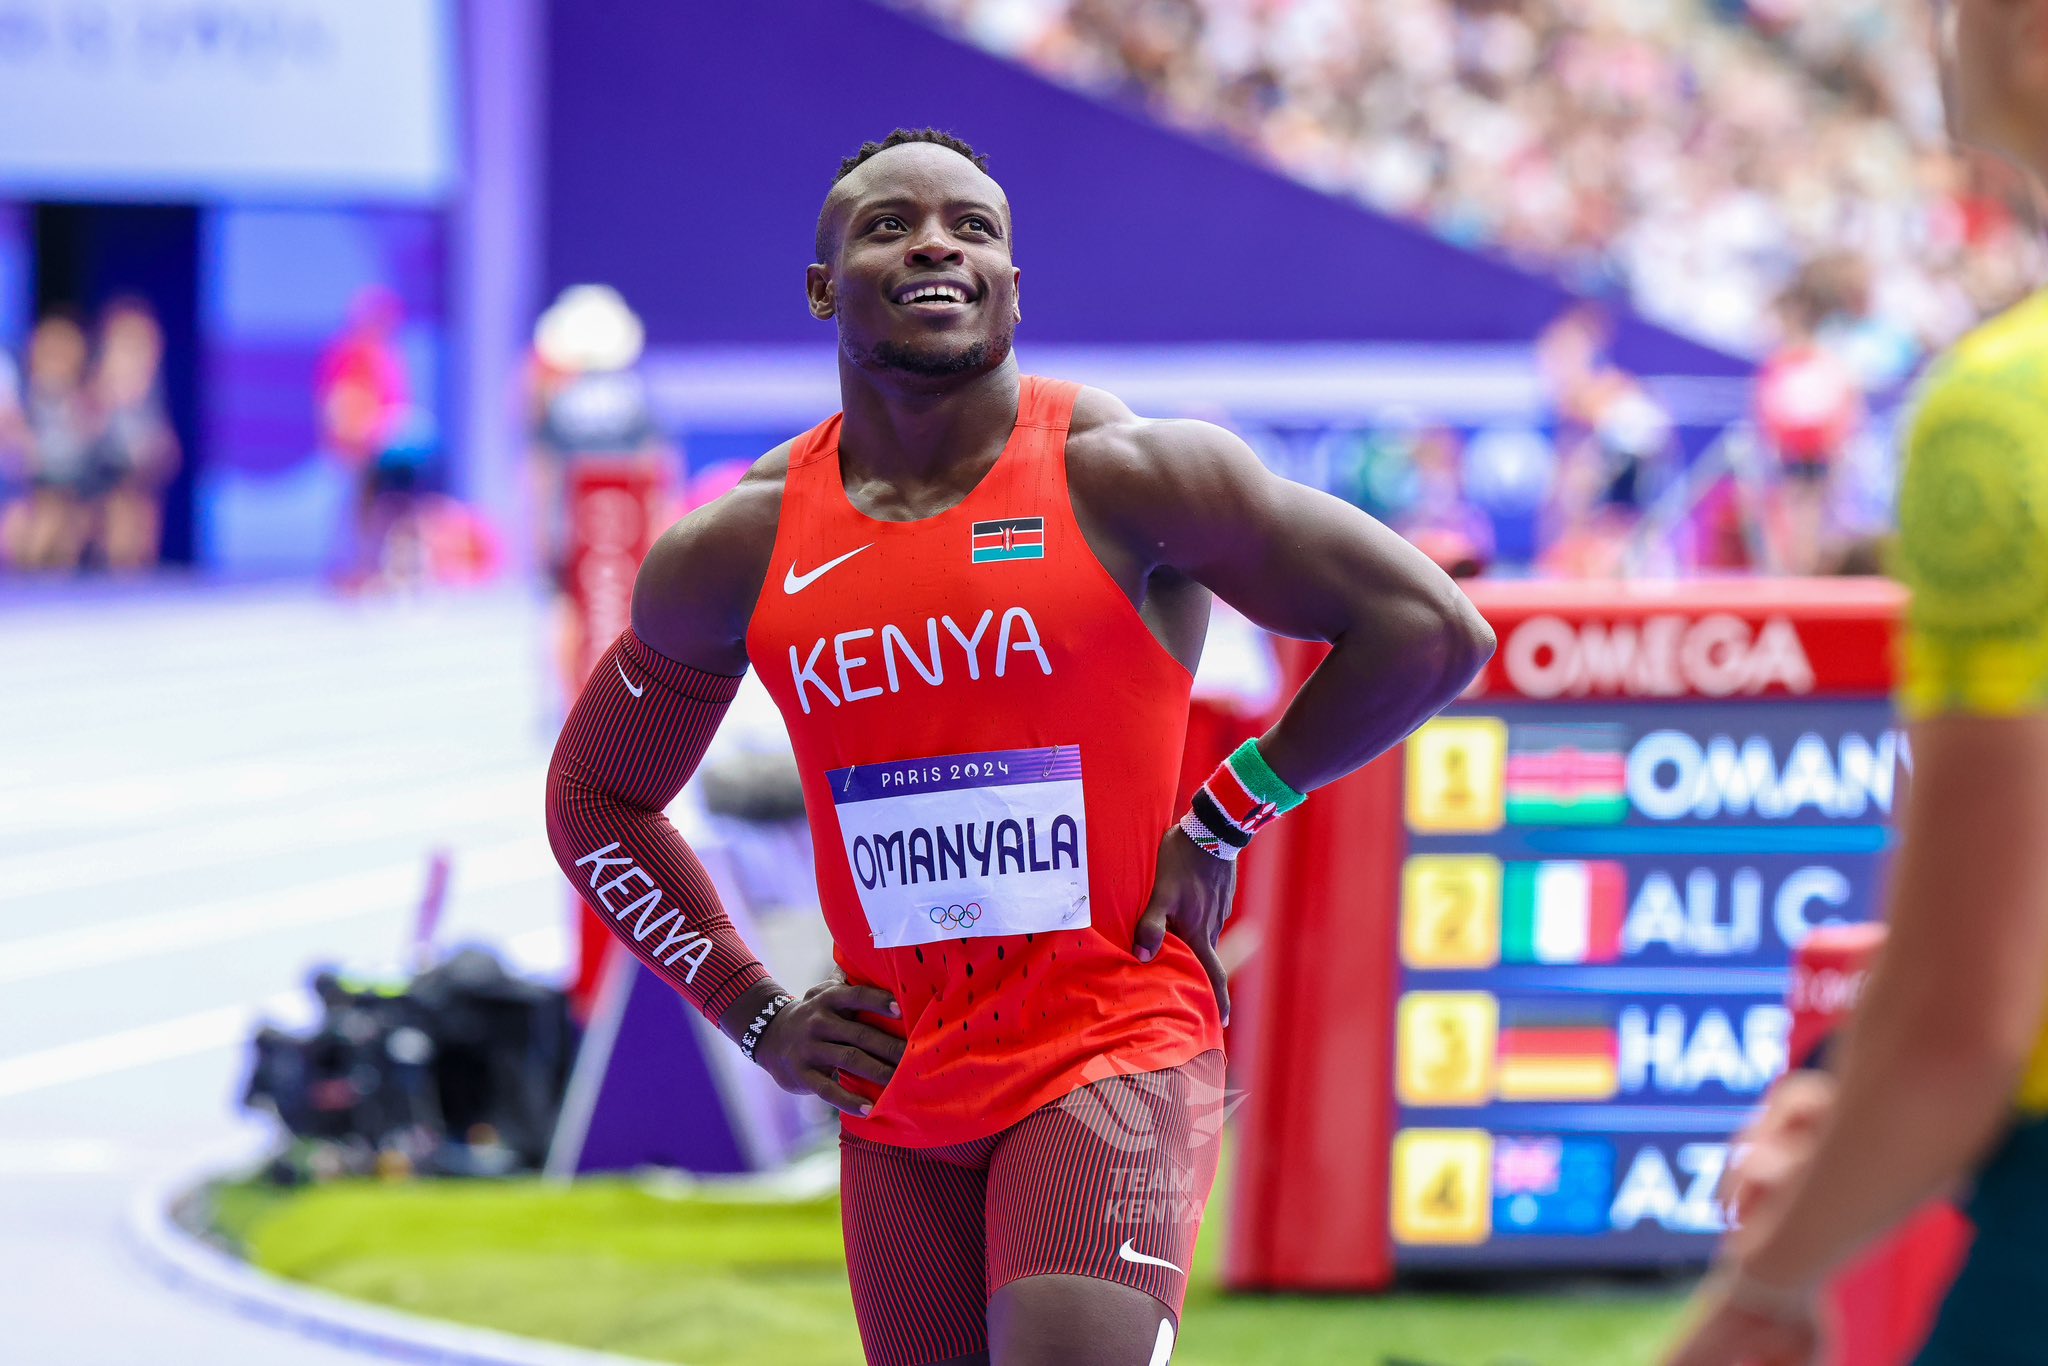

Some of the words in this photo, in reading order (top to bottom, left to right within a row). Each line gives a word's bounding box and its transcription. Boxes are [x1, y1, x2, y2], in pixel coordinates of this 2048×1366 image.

[789, 607, 1053, 715] KENYA
[1505, 614, 1816, 698] OMEGA
[1627, 729, 1910, 820] OMAN
[852, 814, 1080, 890] OMANYALA
[575, 841, 713, 984] KENYA
[1621, 866, 1763, 956] ALI
